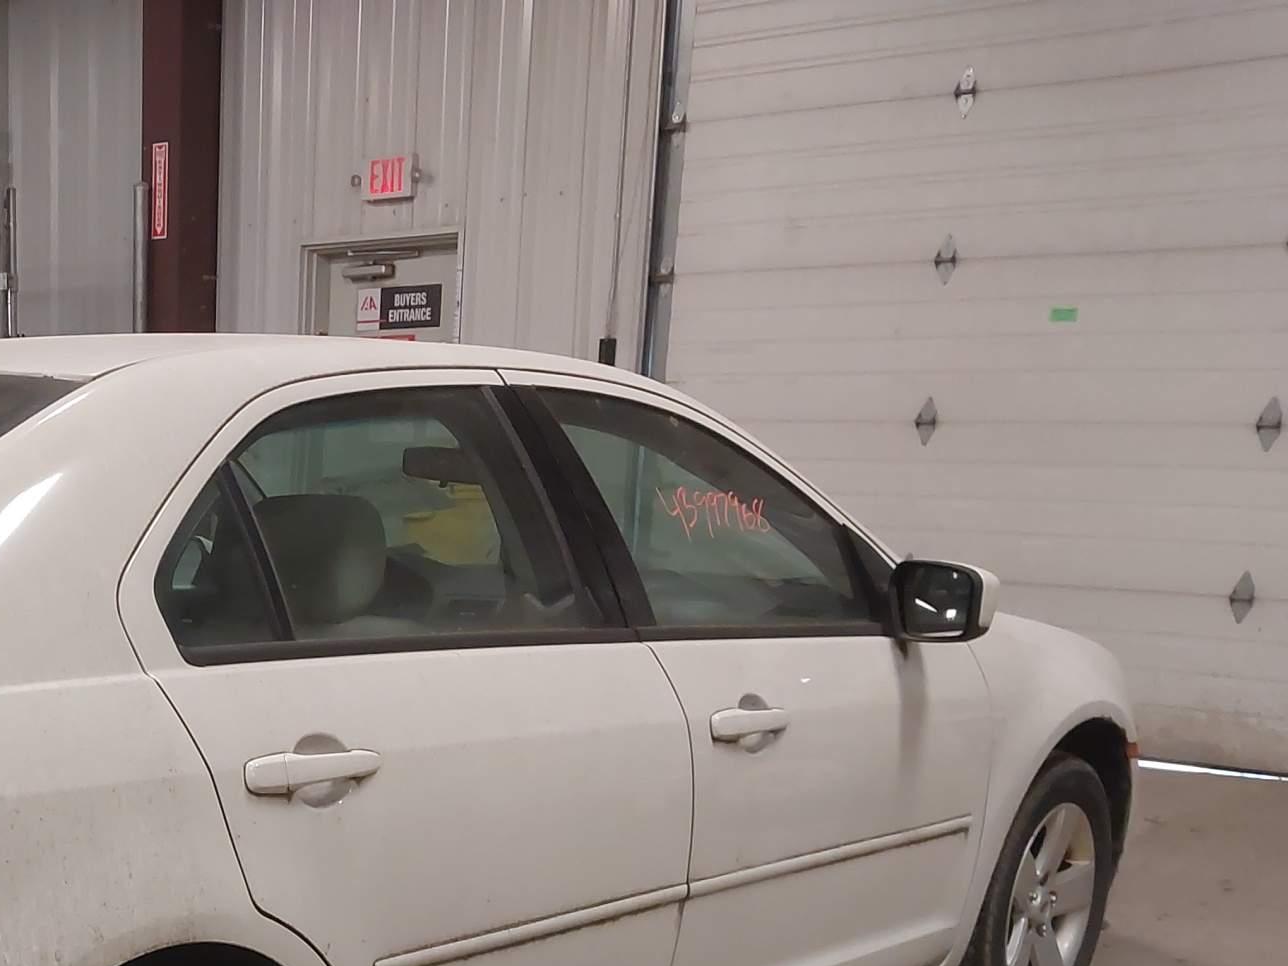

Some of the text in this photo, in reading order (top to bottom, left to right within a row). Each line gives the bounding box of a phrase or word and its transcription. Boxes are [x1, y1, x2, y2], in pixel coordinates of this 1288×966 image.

[369, 156, 406, 194] EXIT
[394, 291, 427, 307] BUYERS
[388, 307, 432, 322] ENTRANCE
[655, 486, 771, 540] 43997968
